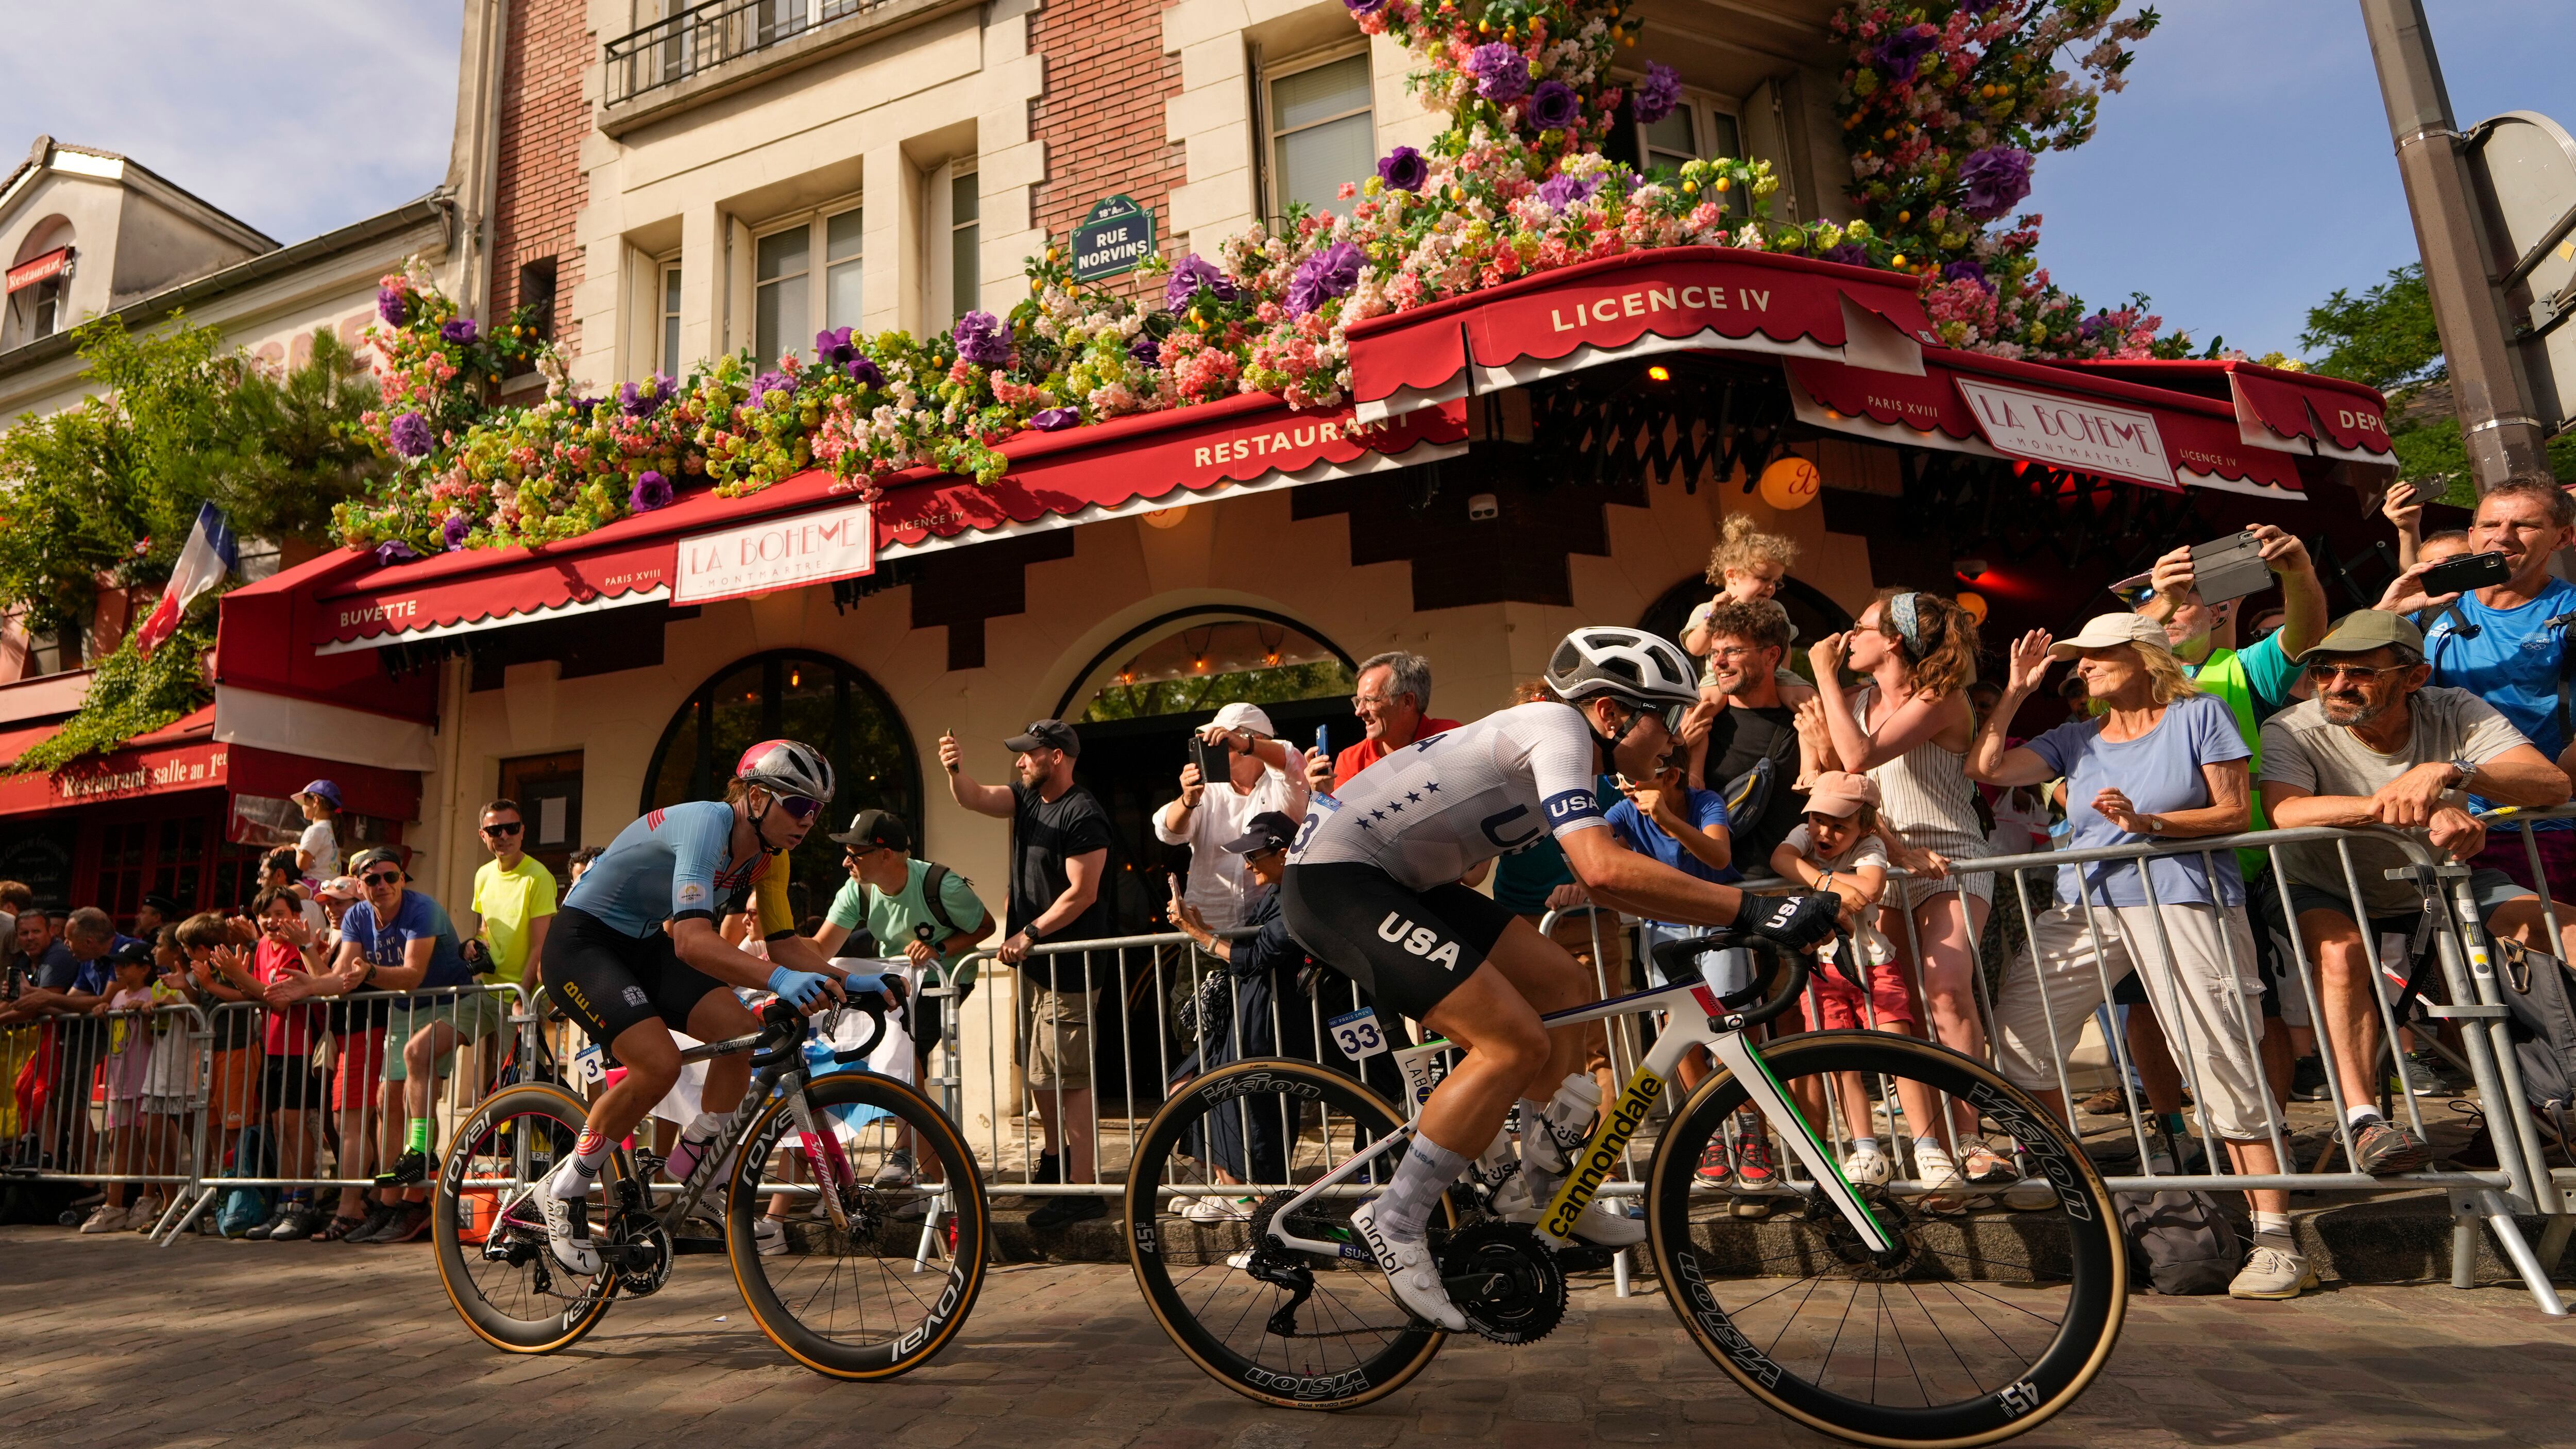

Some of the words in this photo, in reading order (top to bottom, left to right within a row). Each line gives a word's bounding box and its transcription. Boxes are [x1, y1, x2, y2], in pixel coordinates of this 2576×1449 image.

[1096, 227, 1128, 248] RUE
[1078, 240, 1147, 269] NORVINS
[1551, 286, 1727, 332] LICENCE
[1740, 288, 1770, 312] IV
[1868, 395, 1902, 412] PARIS
[1908, 402, 1939, 418] XVIII
[1977, 394, 2025, 429] LA
[2033, 405, 2157, 456] BOHEME
[2017, 436, 2132, 468] MONTMARTRE
[2180, 448, 2222, 466] LICENCE
[2225, 457, 2237, 467] IV
[893, 515, 946, 533] LICENCE
[951, 511, 964, 522] IV
[691, 545, 723, 575] LA
[741, 516, 856, 566] BOHEME
[605, 574, 632, 586] PARIS
[636, 569, 662, 582] XVIII
[708, 560, 823, 587] MONTMARTRE
[341, 599, 416, 628] BUVETTE
[62, 766, 145, 798] Restaurant
[154, 759, 187, 785] salle
[190, 763, 204, 781] au
[740, 766, 793, 778] SPECIALIZED
[1550, 794, 1600, 817] USA
[1765, 896, 1804, 929] USA
[1377, 911, 1461, 972] USA
[563, 981, 599, 1023] BEL
[1338, 1014, 1354, 1023] PARIS
[1355, 1010, 1369, 1018] 2024
[713, 1037, 757, 1052] SPECIALIZED
[1340, 1023, 1380, 1054] 33
[586, 1059, 598, 1077] 3
[1201, 1073, 1321, 1106] Vision
[444, 1111, 490, 1197] roval
[677, 1091, 760, 1215] S-WORKS
[742, 1107, 794, 1187] rova
[1415, 1150, 1435, 1168] USA
[1549, 1076, 1662, 1239] cannondale
[1967, 1081, 2094, 1222] Vision
[812, 1139, 841, 1213] SPECIALIZED
[1137, 1228, 1156, 1253] 45
[1344, 1248, 1375, 1261] SUP
[1359, 1216, 1404, 1276] nimbl
[891, 1266, 964, 1362] roval
[1677, 1252, 1782, 1389] Vision
[1245, 1367, 1370, 1400] Vision
[2001, 1381, 2040, 1414] 45
